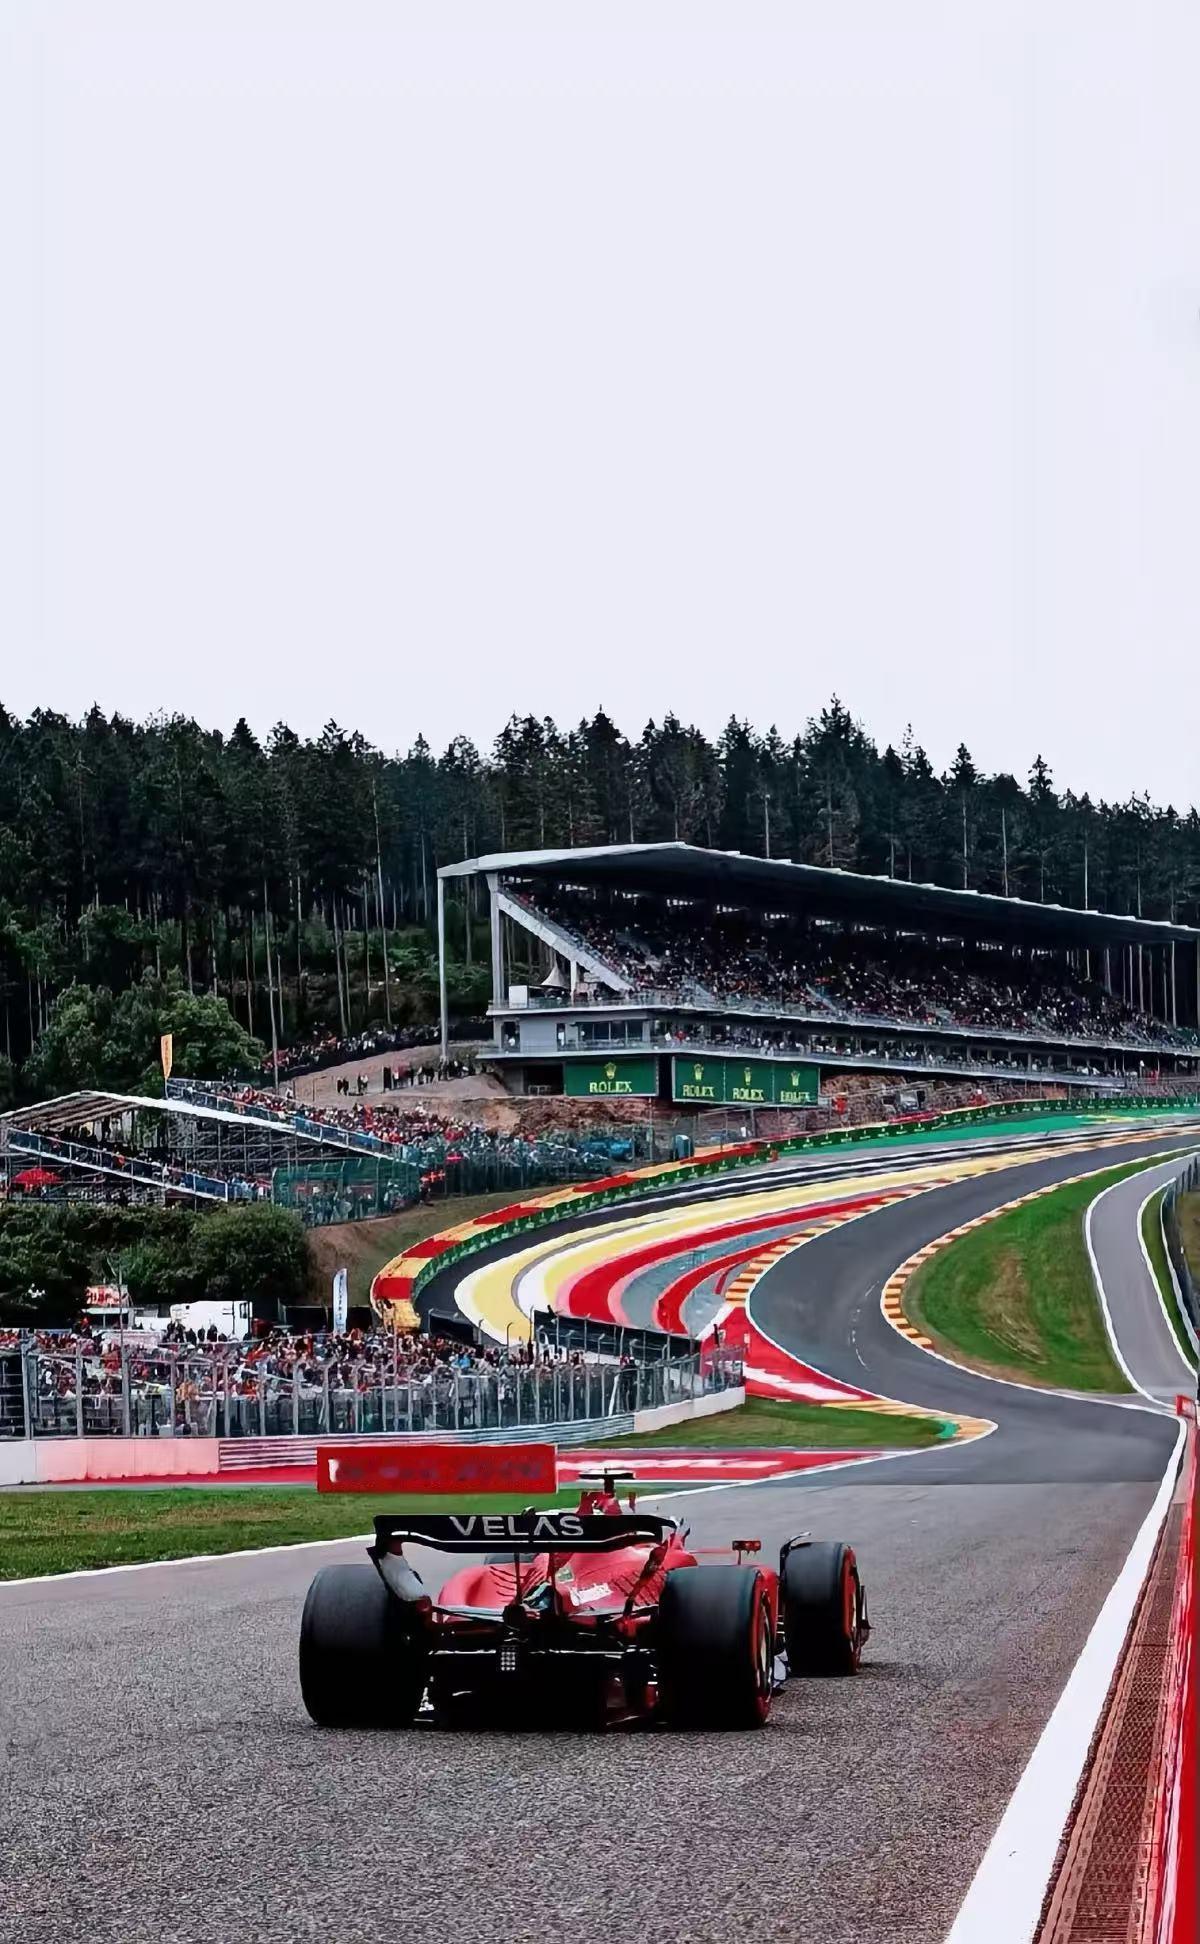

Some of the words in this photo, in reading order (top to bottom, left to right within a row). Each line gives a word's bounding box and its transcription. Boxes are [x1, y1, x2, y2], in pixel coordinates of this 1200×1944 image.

[589, 1081, 633, 1093] ROLEX
[682, 1084, 715, 1098] ROLEX
[732, 1087, 765, 1101] ROLEX
[449, 1515, 584, 1536] VELAS
